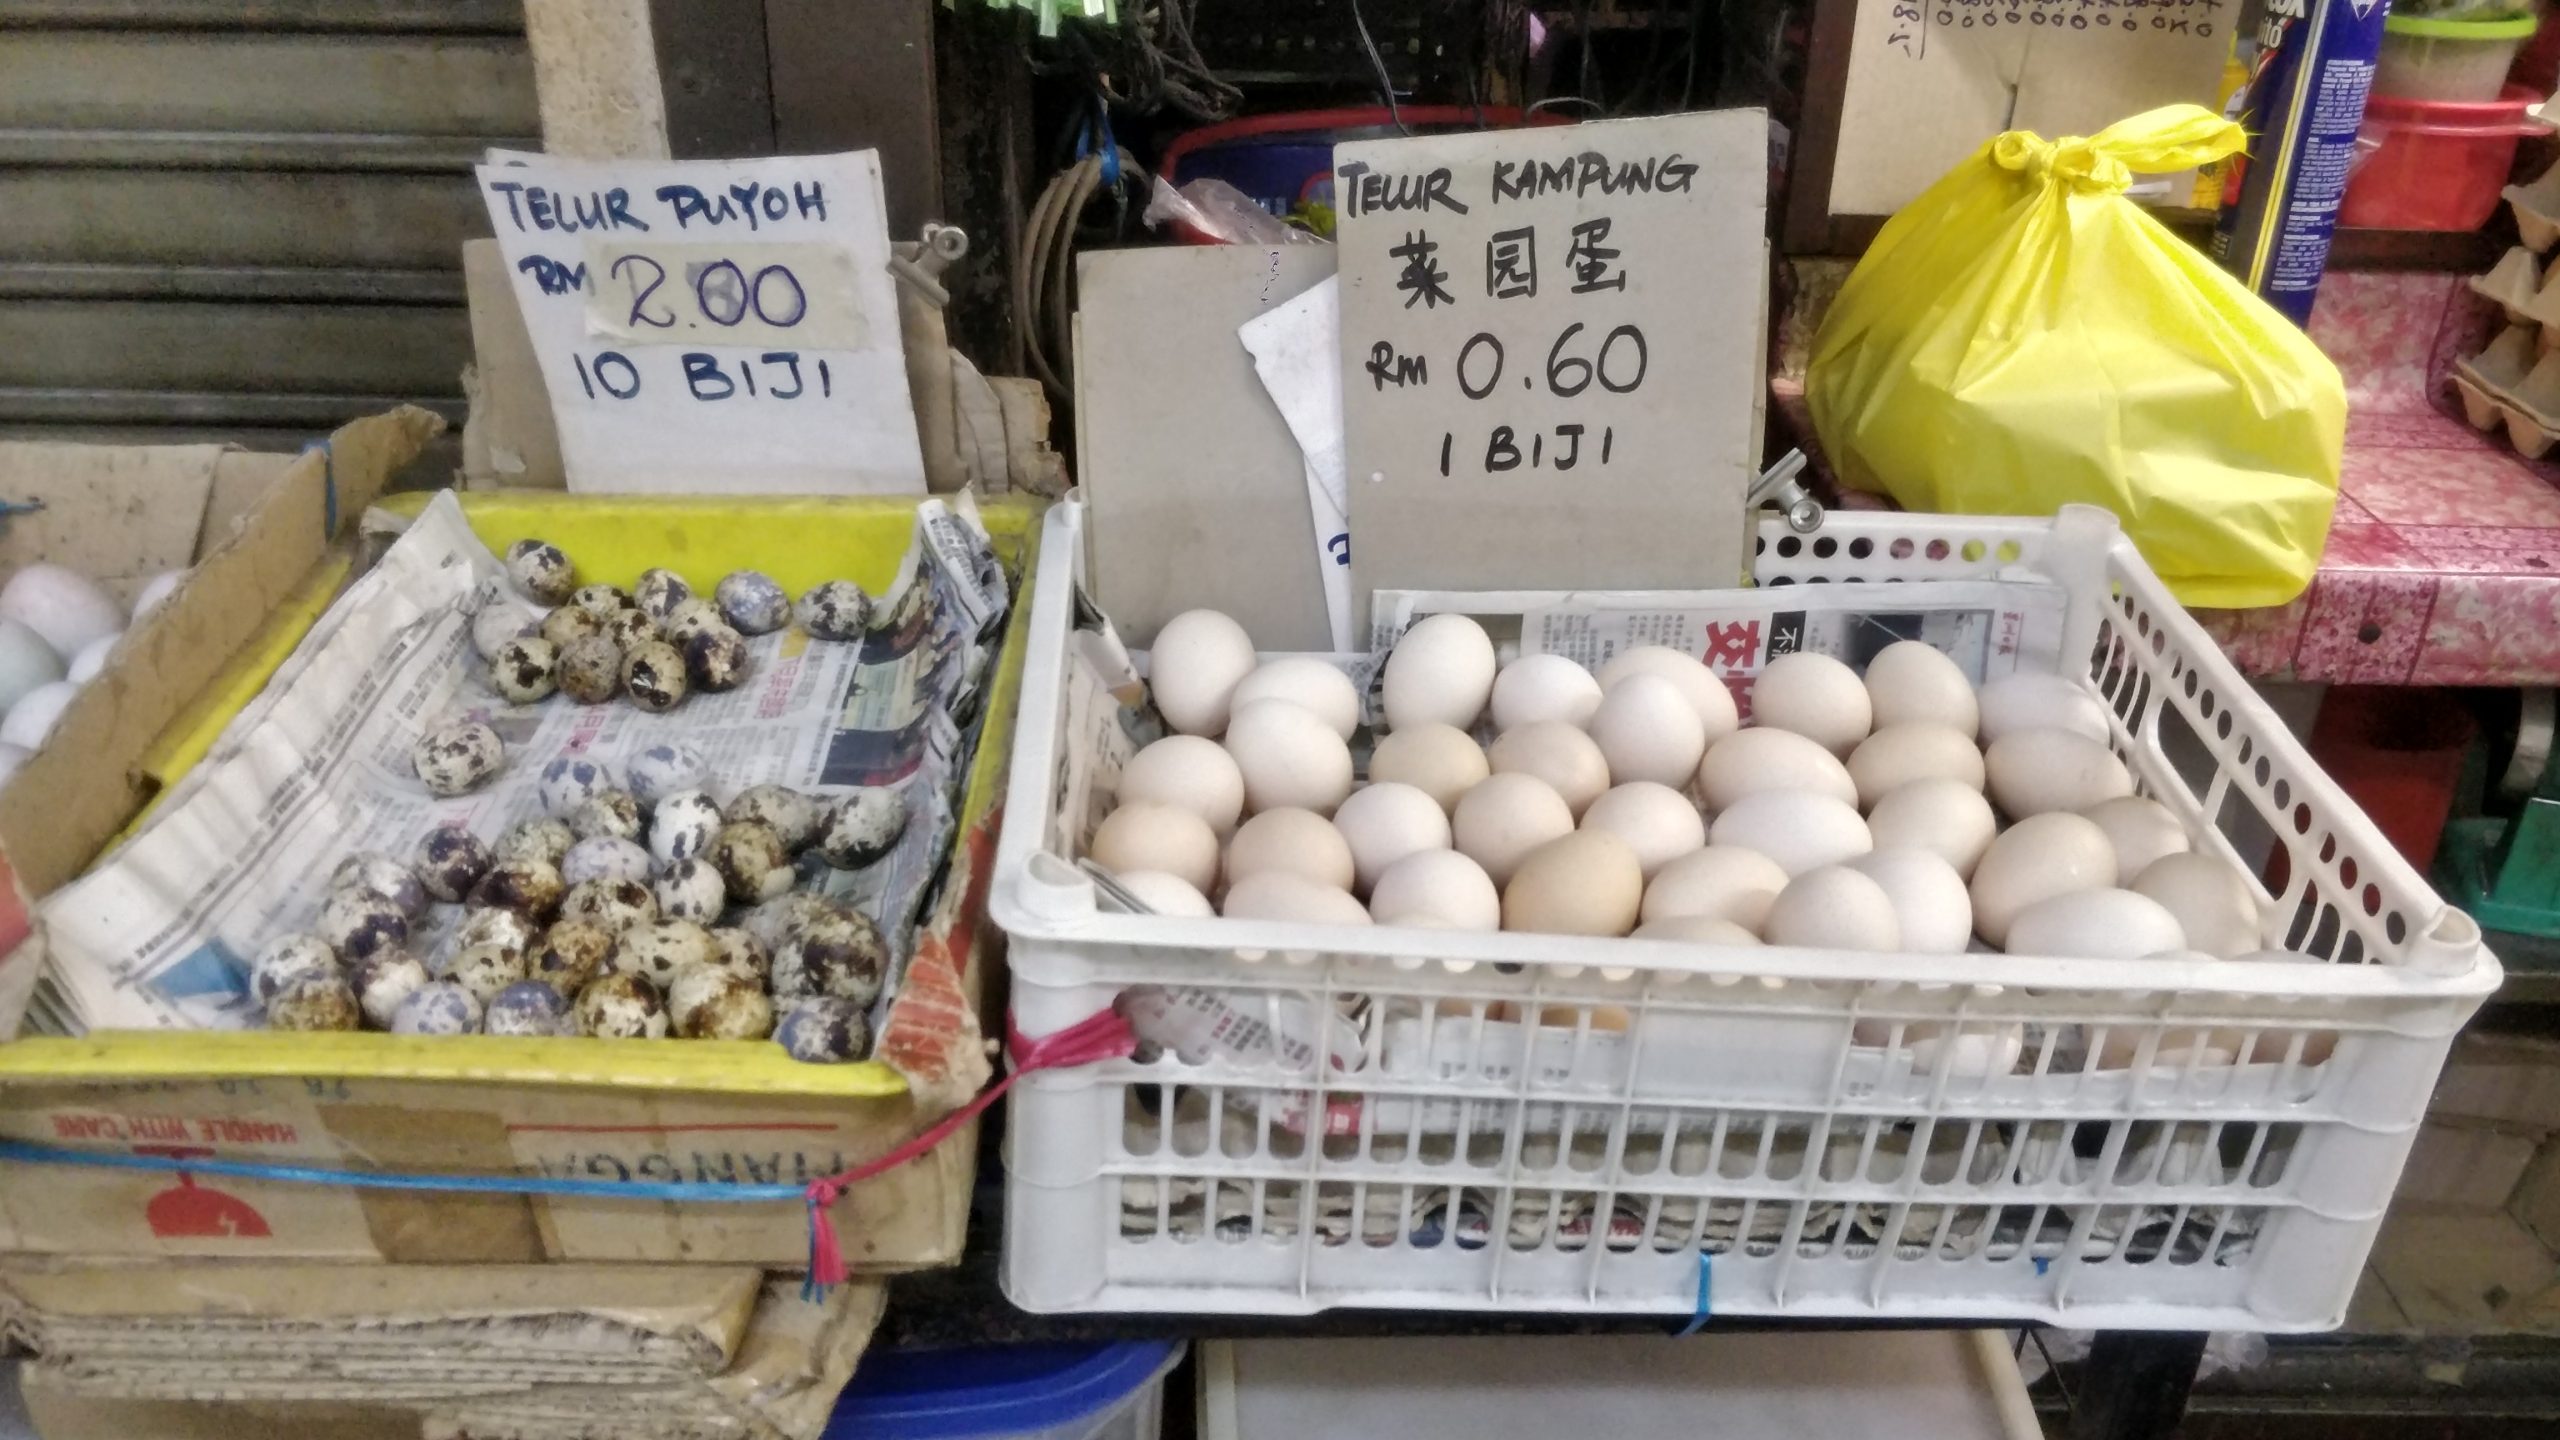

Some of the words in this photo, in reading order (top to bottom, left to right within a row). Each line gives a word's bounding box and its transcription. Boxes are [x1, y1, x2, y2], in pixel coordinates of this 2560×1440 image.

[490, 180, 651, 232] TELUR
[656, 180, 827, 231] PUYOH
[1337, 161, 1470, 219] TELUR
[1492, 153, 1700, 205] KAMPUNG
[610, 254, 808, 328] 2.00
[573, 350, 642, 400] 10
[682, 351, 831, 401] BIJI
[1457, 322, 1648, 400] 0.60
[1485, 424, 1613, 473] BIJI
[48, 1114, 119, 1139] CARE
[128, 1118, 194, 1142] WITH
[196, 1118, 299, 1144] HANDLE
